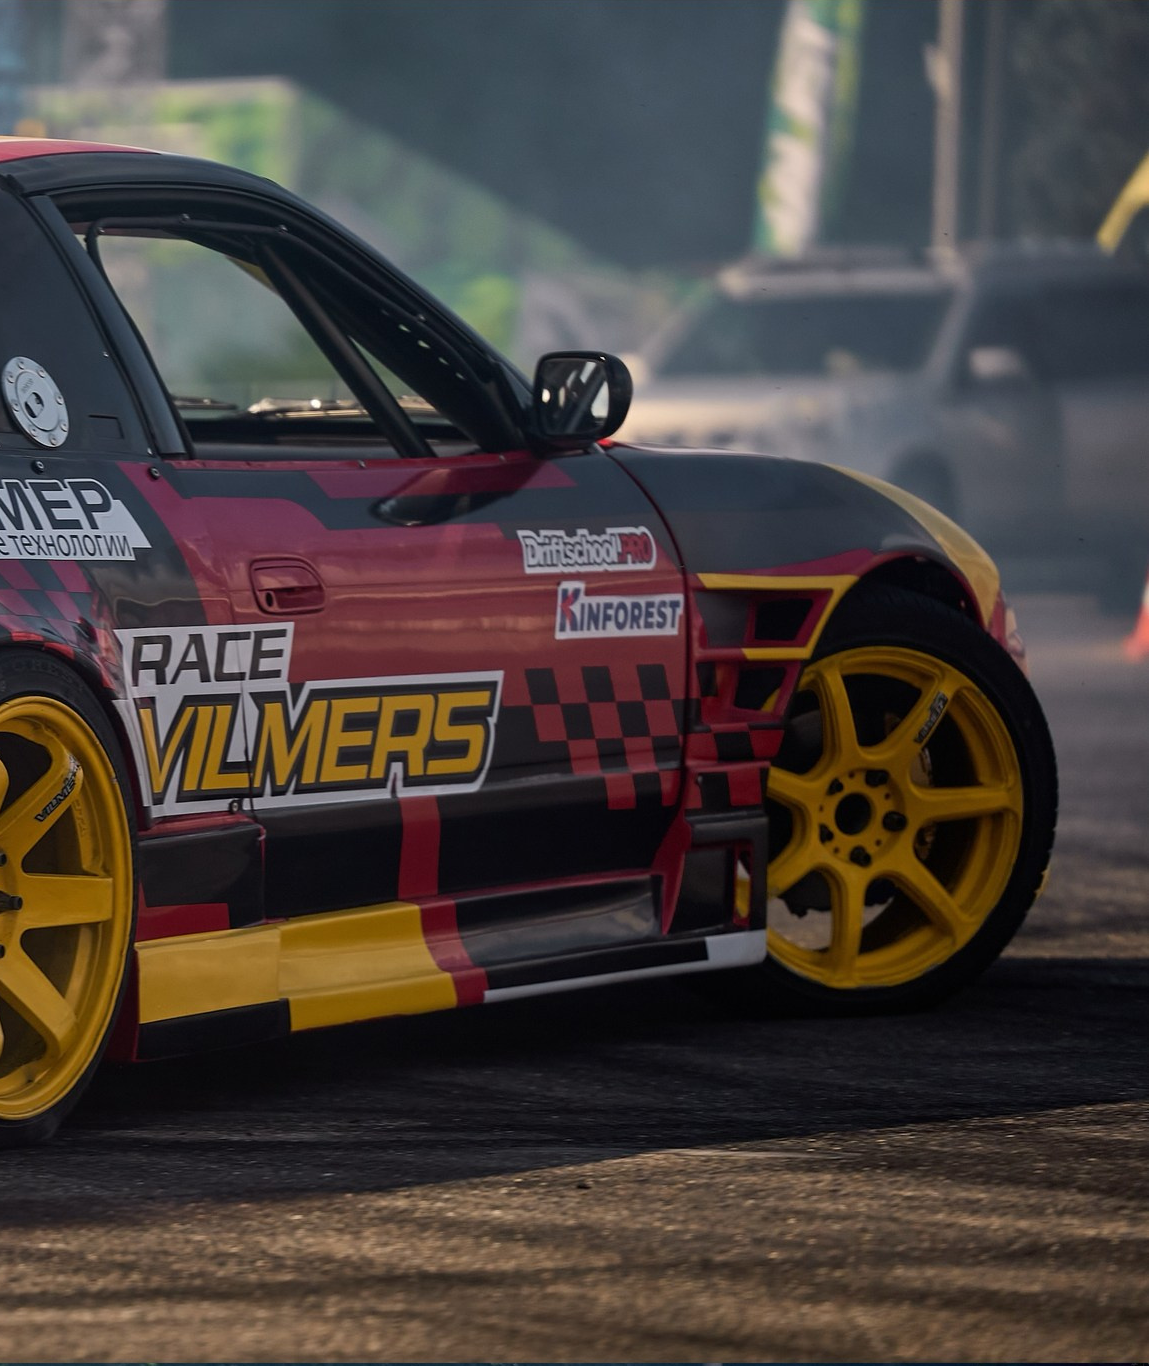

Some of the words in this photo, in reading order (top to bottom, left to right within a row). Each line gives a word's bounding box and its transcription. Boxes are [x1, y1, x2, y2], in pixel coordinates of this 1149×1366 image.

[558, 588, 681, 632] KINFOREST
[131, 627, 288, 686] RACE
[137, 685, 495, 799] VILMERS
